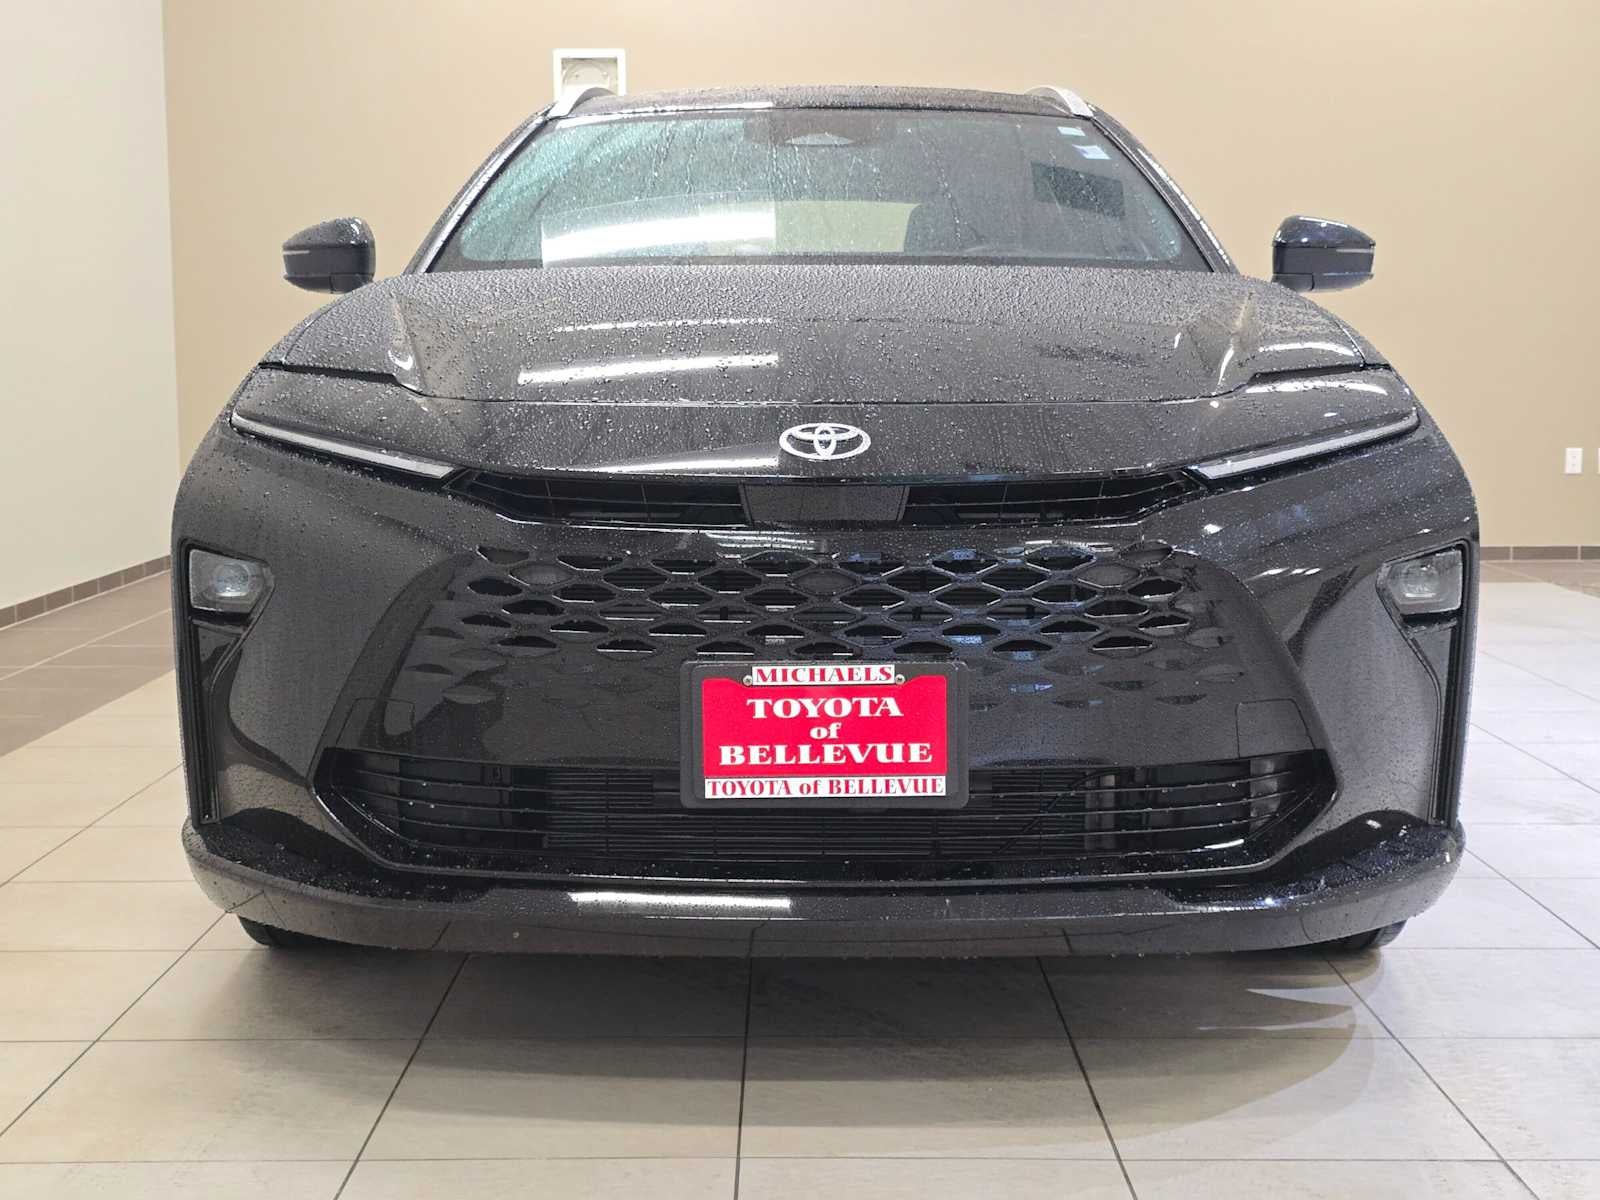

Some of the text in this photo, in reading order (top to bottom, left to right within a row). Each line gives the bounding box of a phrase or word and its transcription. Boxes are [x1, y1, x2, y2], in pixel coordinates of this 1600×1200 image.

[755, 667, 893, 683] MICHAELS
[746, 697, 904, 719] TOYOTA
[810, 722, 842, 740] of
[719, 743, 933, 766] BELLEVUE
[707, 778, 945, 796] TOYOTA of BELLEVUE
